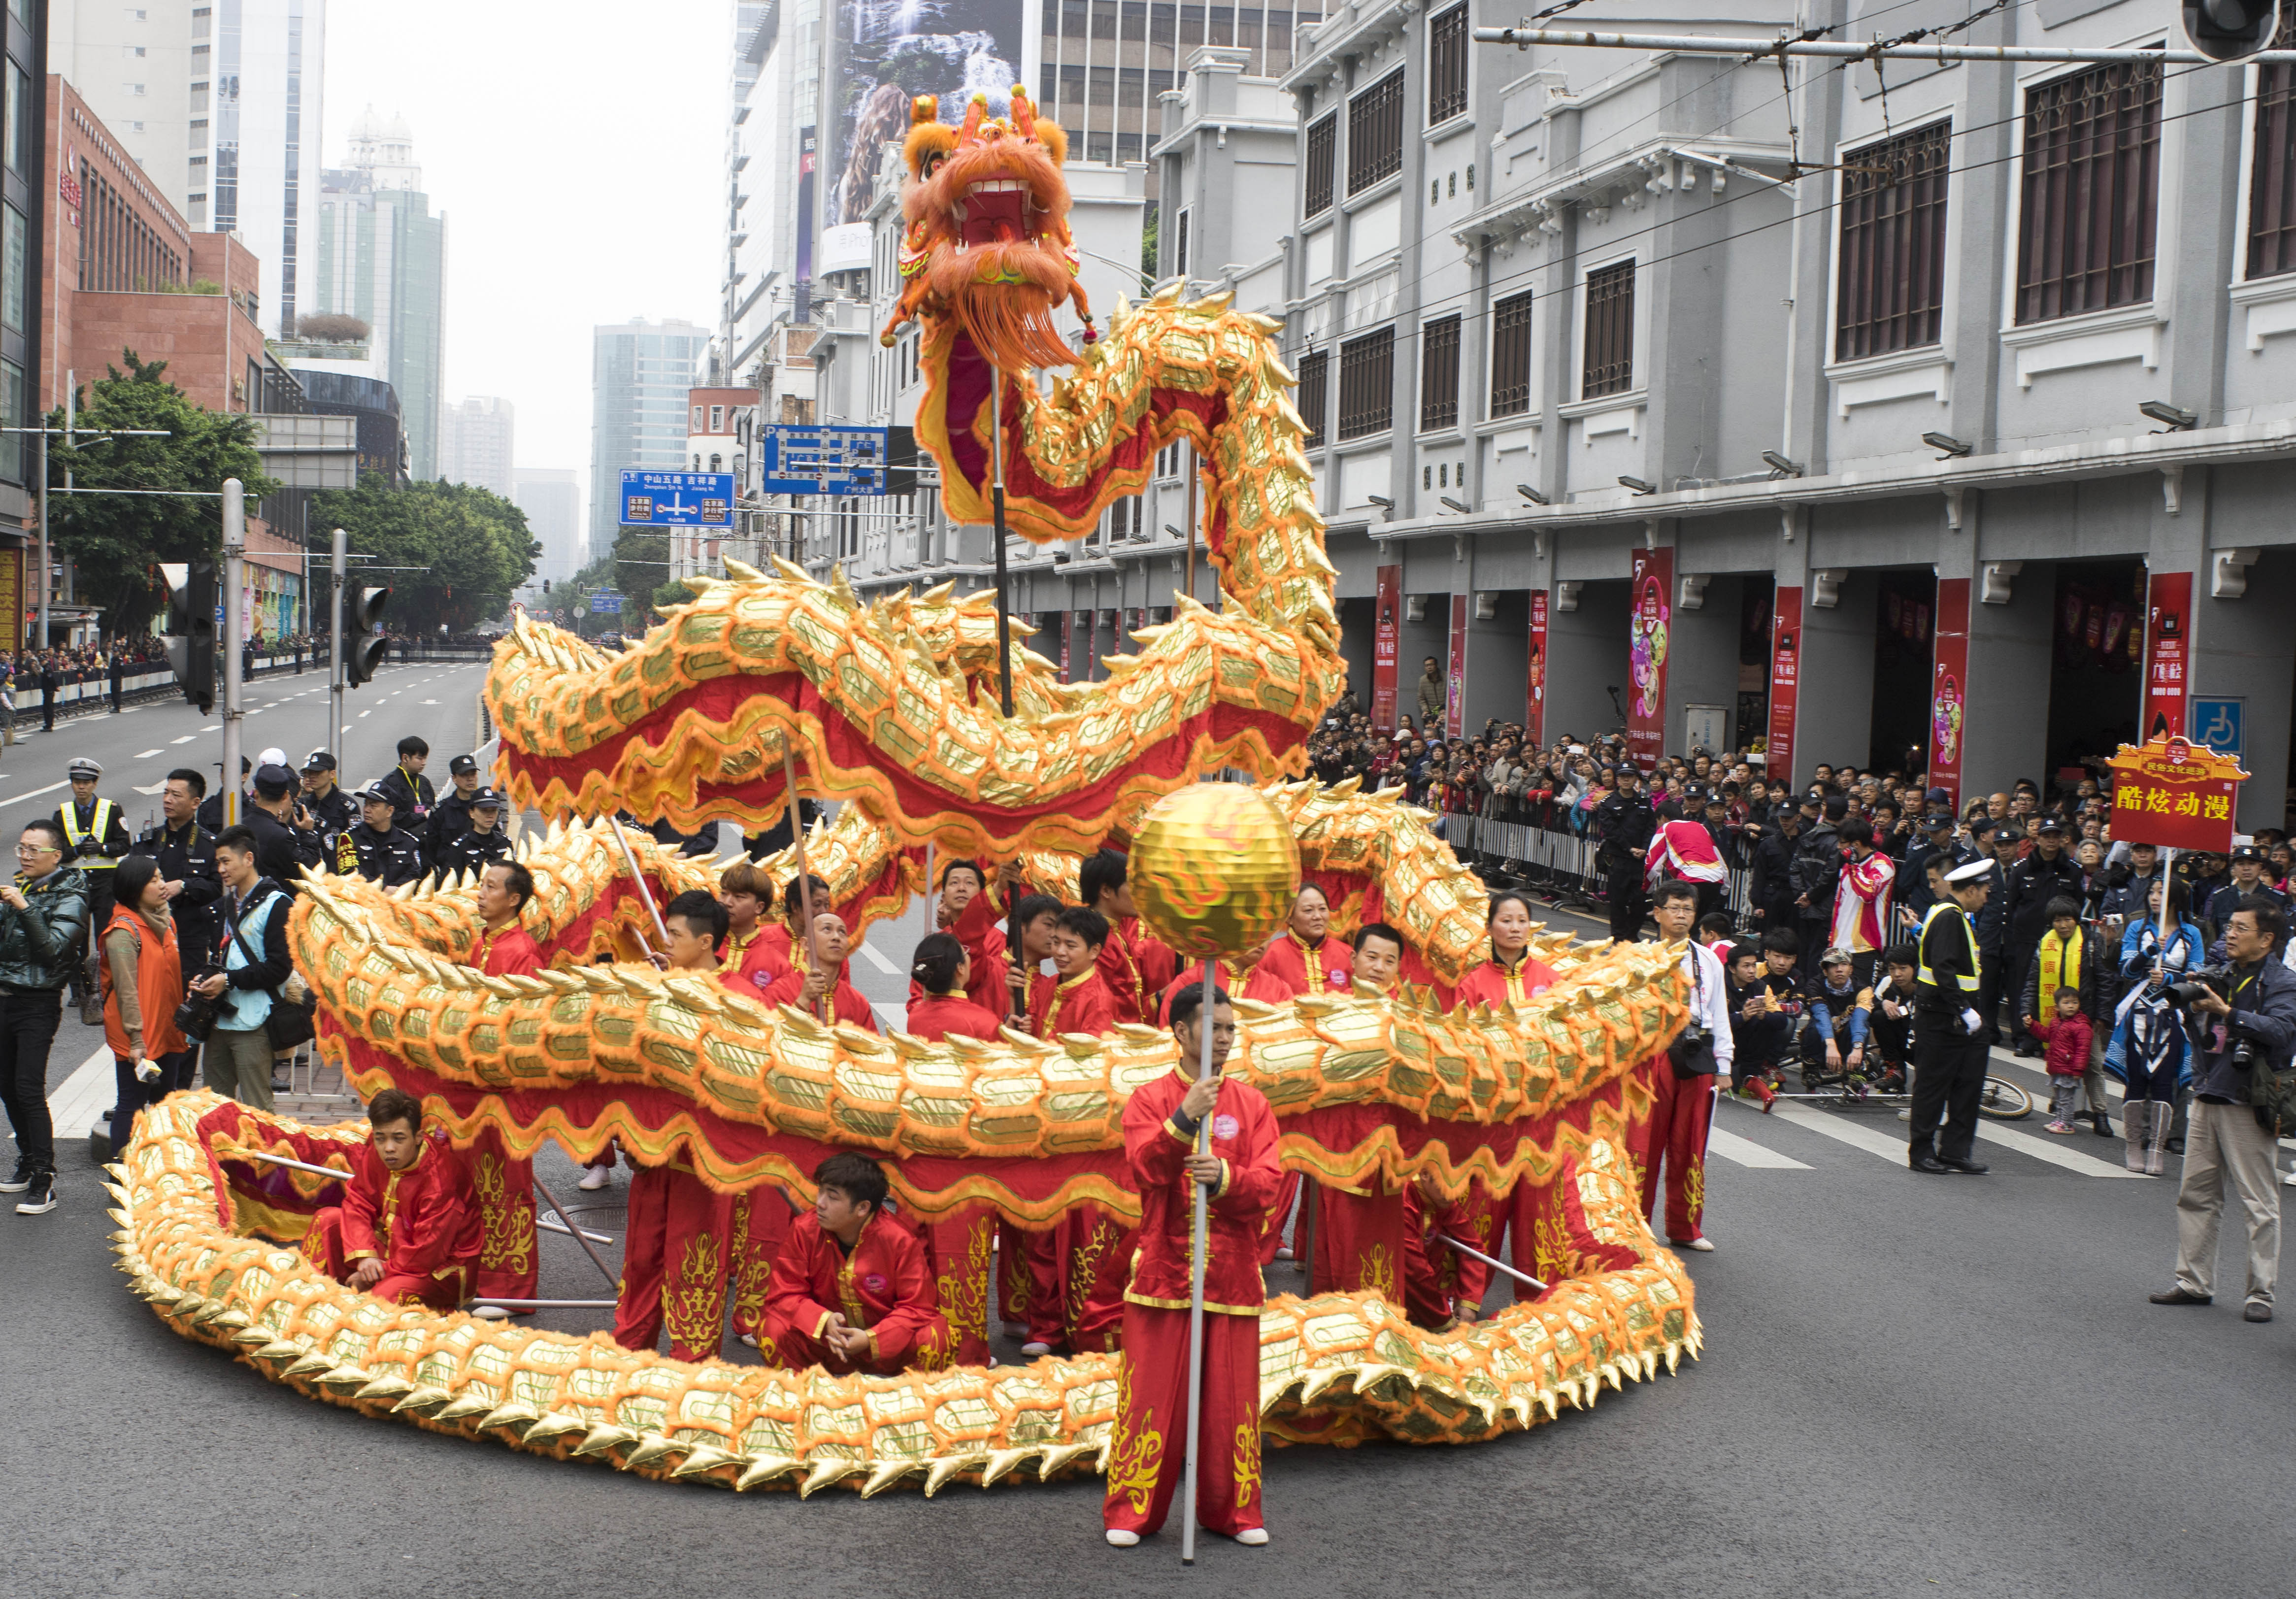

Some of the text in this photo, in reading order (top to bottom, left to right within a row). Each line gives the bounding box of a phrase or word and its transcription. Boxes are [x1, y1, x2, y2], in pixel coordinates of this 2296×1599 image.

[766, 426, 776, 438] P
[644, 474, 682, 484] 中山五路
[687, 475, 717, 486] 吉祥路
[2117, 785, 2230, 820] 酷炫动漫
